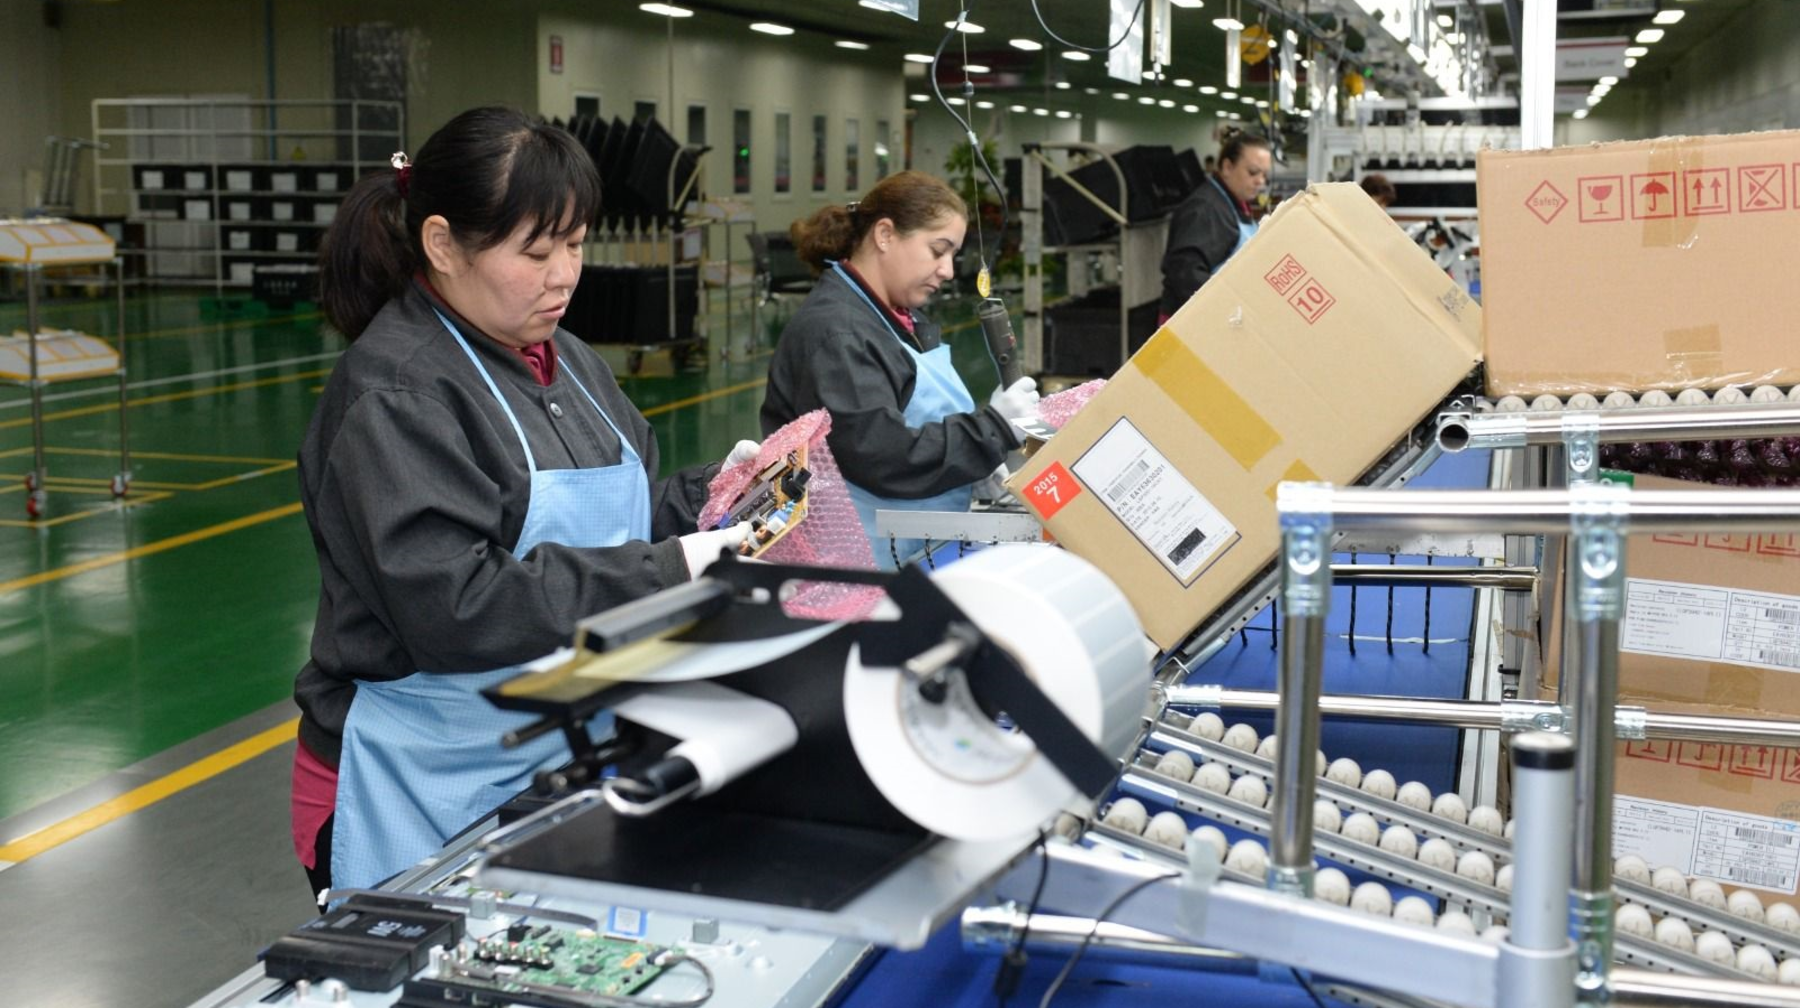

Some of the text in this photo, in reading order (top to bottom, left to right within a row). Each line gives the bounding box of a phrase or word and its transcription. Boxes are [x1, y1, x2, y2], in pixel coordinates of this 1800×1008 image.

[1533, 197, 1559, 208] Safety
[1270, 260, 1301, 291] RoHS
[1297, 286, 1324, 312] 10
[1033, 472, 1058, 495] 2015
[1046, 485, 1061, 503] 7
